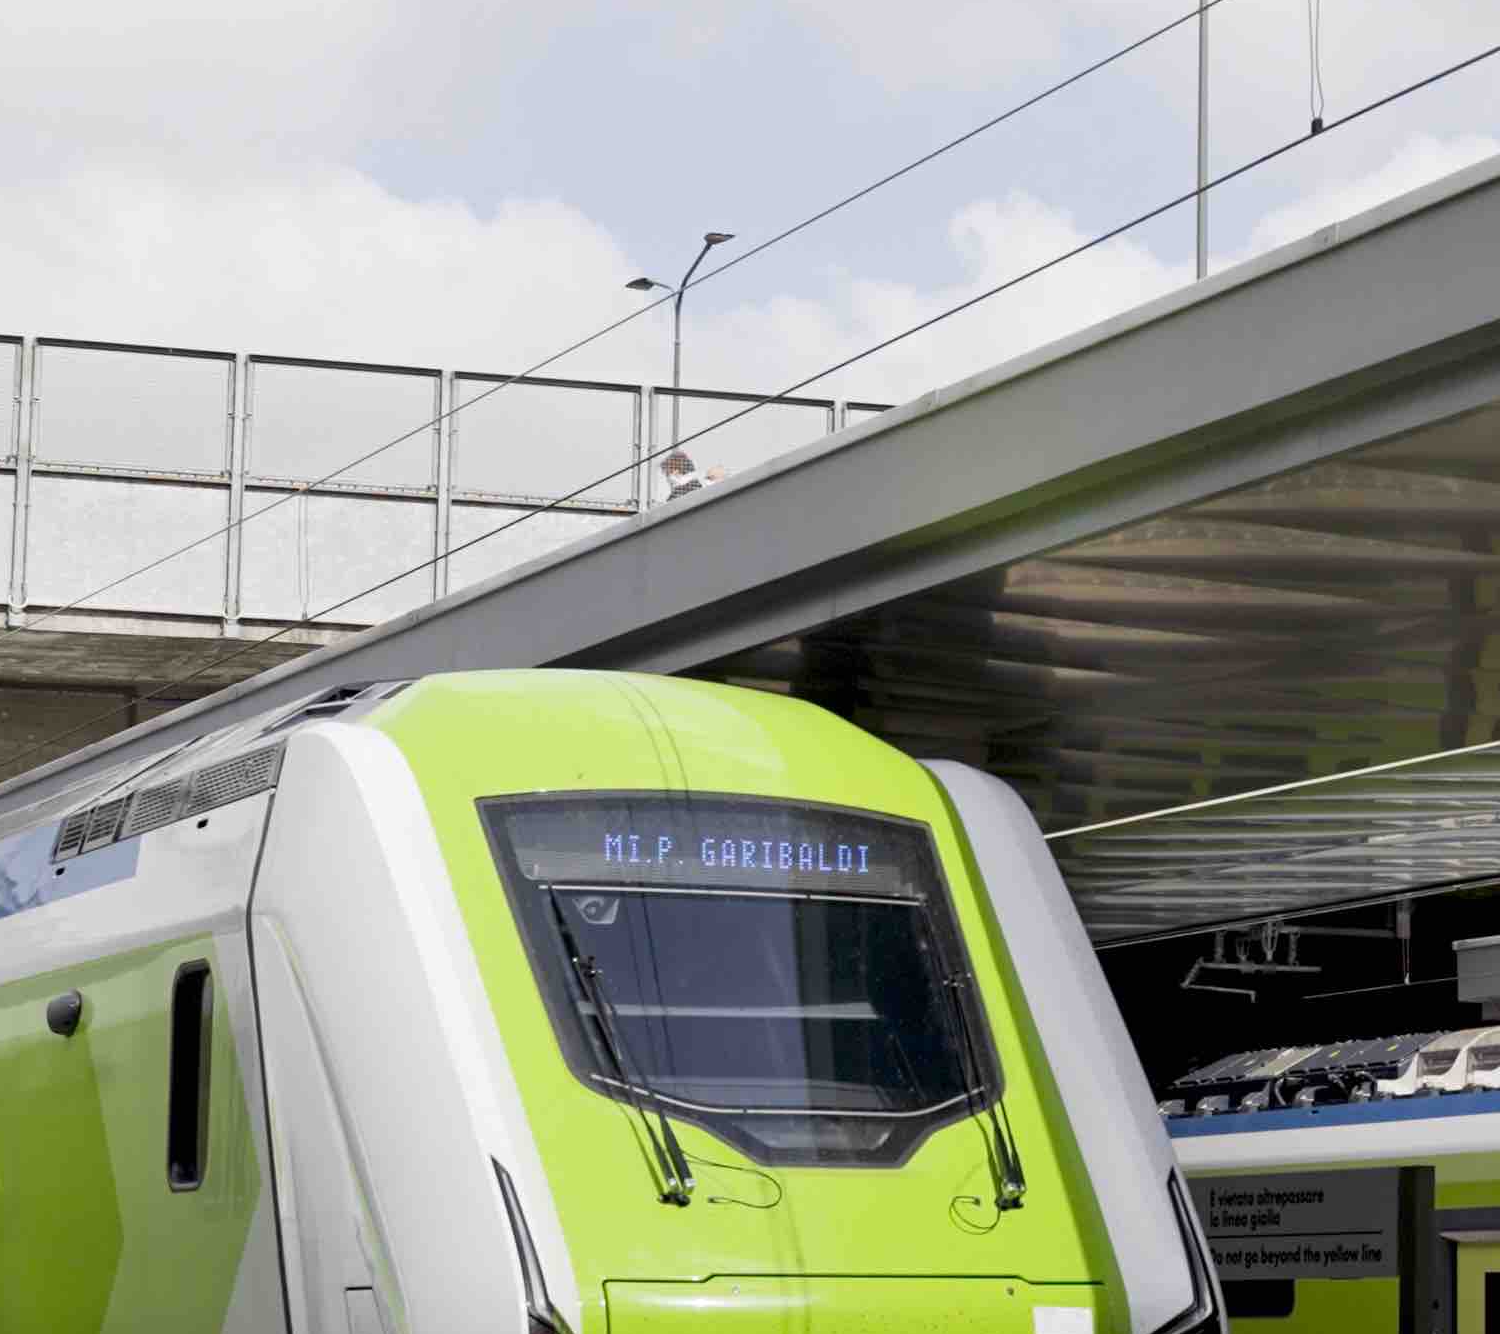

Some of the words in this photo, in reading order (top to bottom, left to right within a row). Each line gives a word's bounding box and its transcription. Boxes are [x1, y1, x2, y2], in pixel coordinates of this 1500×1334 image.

[701, 838, 870, 873] GARIBALDI
[1256, 1188, 1324, 1207] oltrepassare
[1222, 1210, 1249, 1227] linea
[1250, 1209, 1281, 1230] gialla
[1226, 1247, 1243, 1264] not
[1245, 1250, 1258, 1268] go
[1260, 1246, 1301, 1267] beyond
[1303, 1246, 1320, 1262] the
[1323, 1244, 1359, 1265] yellow
[1362, 1244, 1382, 1262] line
